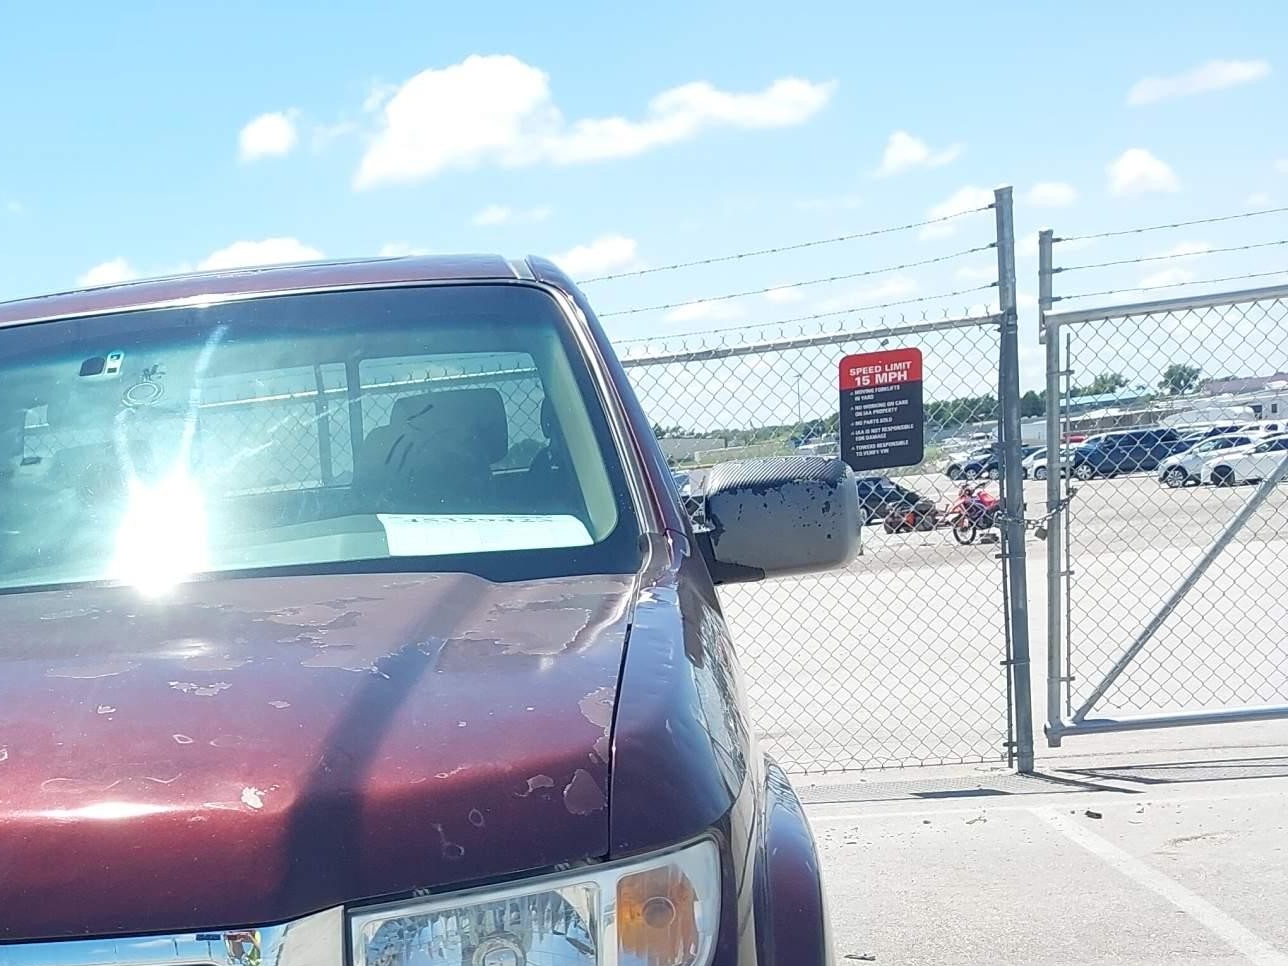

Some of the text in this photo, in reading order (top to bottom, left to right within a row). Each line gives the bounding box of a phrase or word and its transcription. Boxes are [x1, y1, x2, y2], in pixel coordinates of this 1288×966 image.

[849, 361, 912, 376] SPEED LIMIT
[854, 371, 907, 386] 15 MPH
[854, 385, 900, 395] MOVING FORKLIFTS
[863, 402, 886, 410] WORKING
[872, 407, 898, 415] PROPERTY
[881, 424, 914, 432] RESPONSIBLE
[876, 440, 909, 449] RESPONSIBLE
